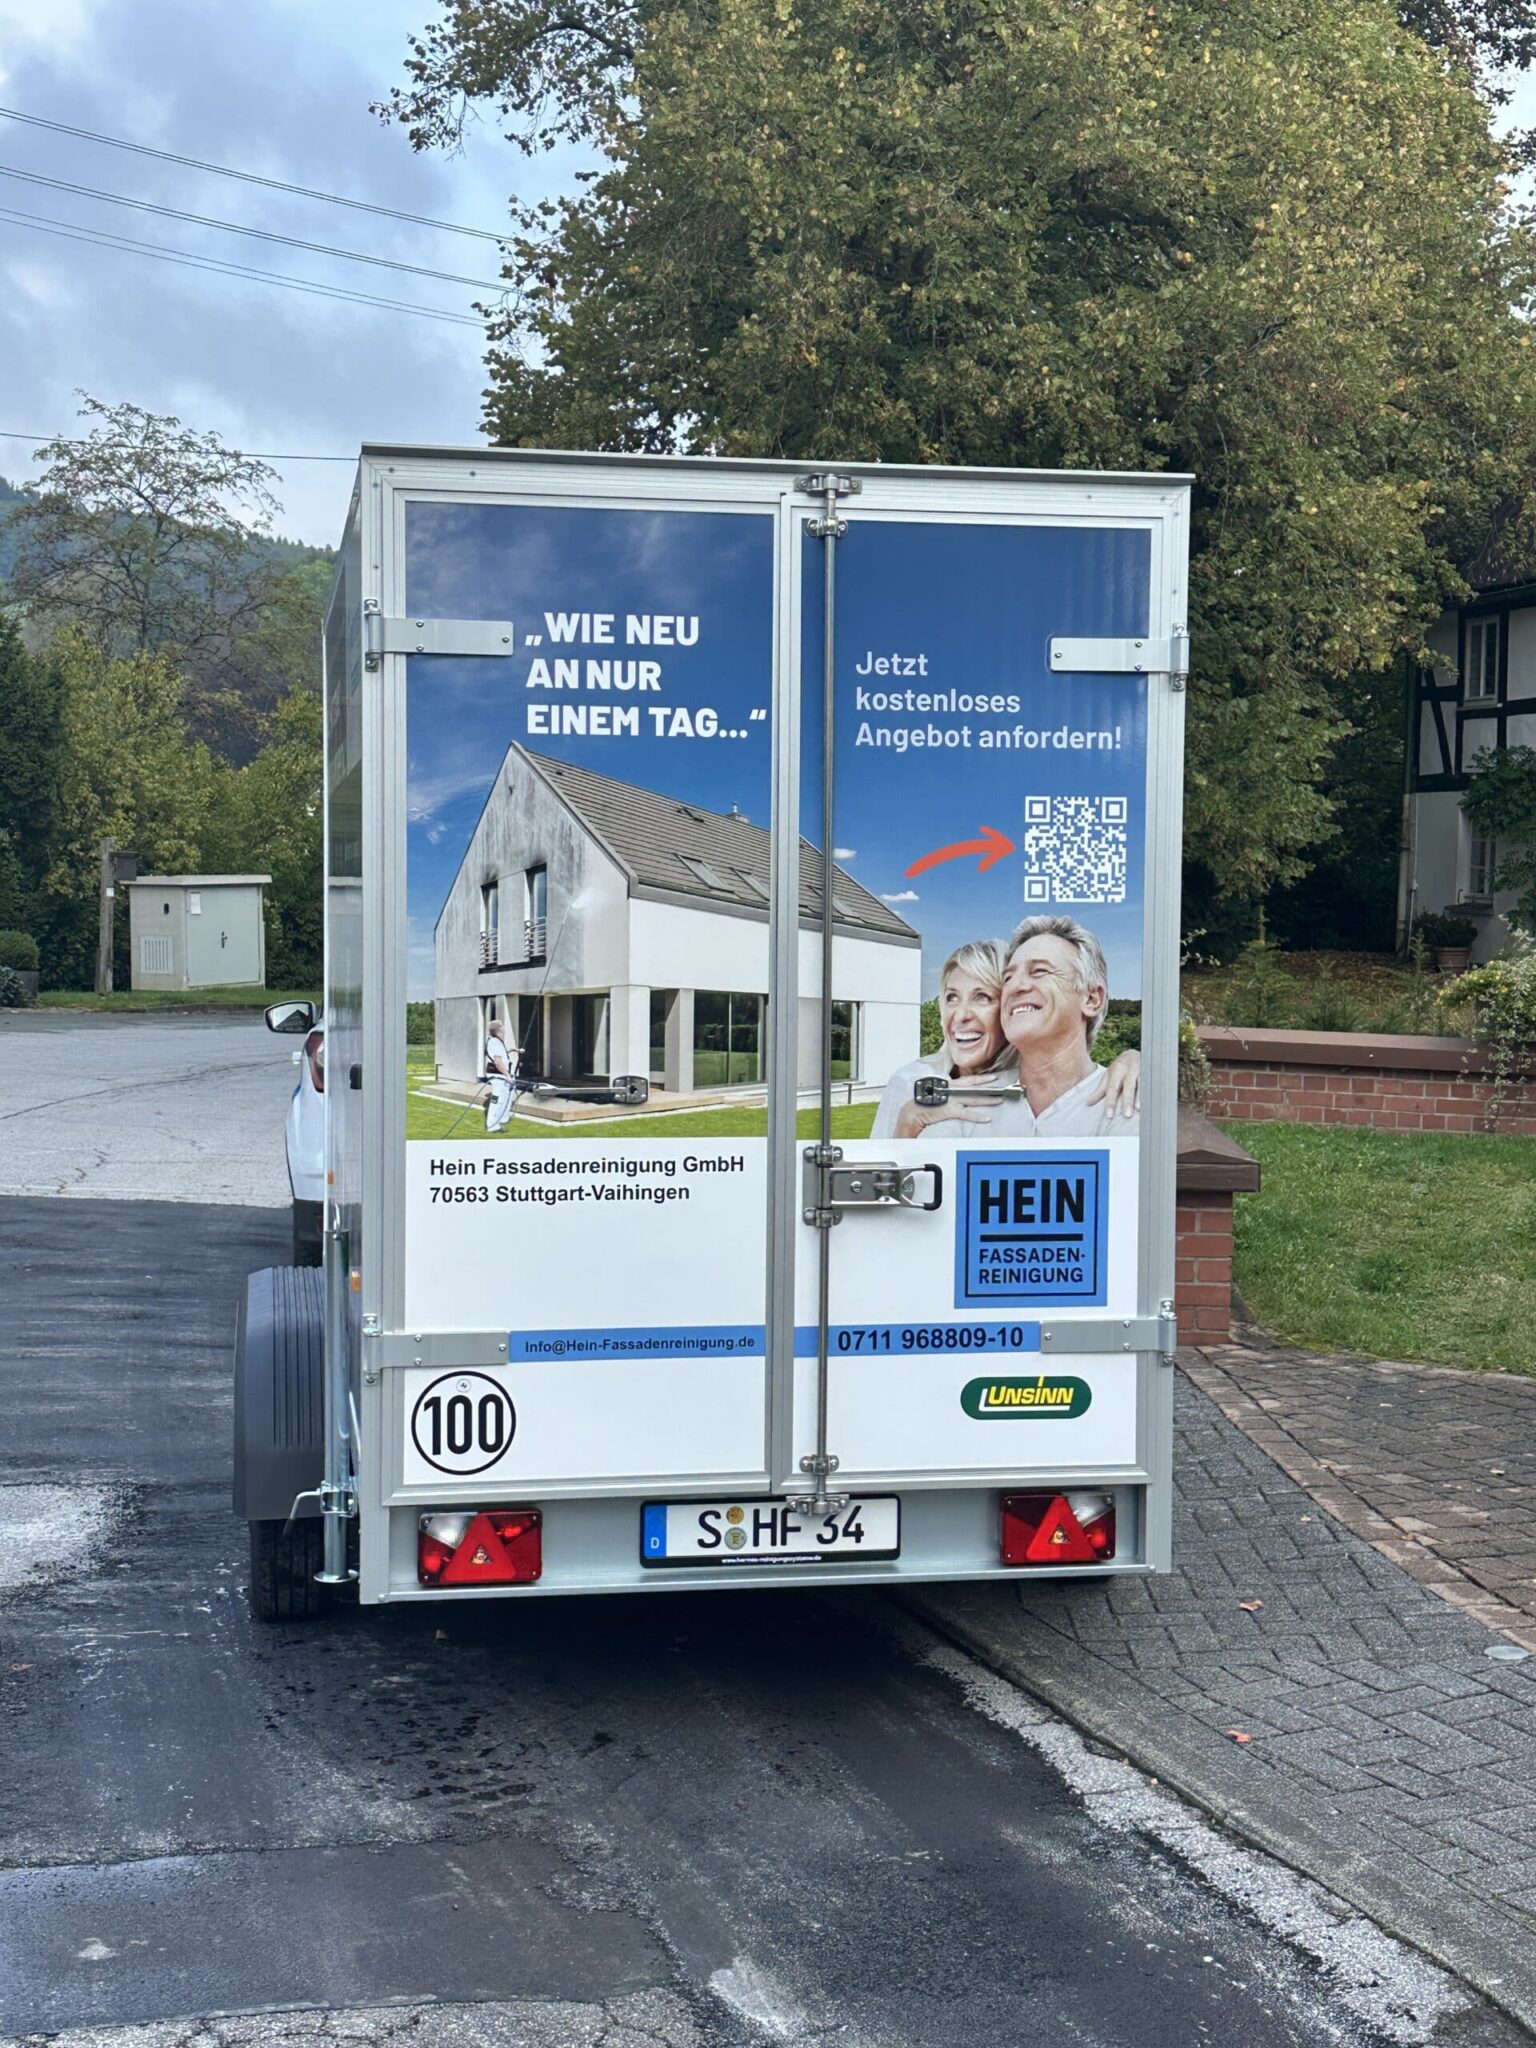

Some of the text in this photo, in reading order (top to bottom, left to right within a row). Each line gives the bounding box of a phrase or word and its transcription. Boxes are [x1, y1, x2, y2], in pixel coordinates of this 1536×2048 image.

[626, 614, 700, 646] NEU
[525, 658, 662, 691] AN NUR
[855, 651, 929, 676] Jetzt
[856, 686, 1022, 713] kostenloses
[527, 704, 640, 736] EINEM
[855, 722, 1122, 753] Angebot anfordern!
[430, 1156, 745, 1177] Hein Fassadenreinigung GmbH
[430, 1184, 690, 1206] 70563 Stuttgart-Vaihingen
[979, 1179, 1086, 1224] HEIN
[979, 1248, 1086, 1264] FASSADEN-
[978, 1268, 1084, 1285] REINIGUNG
[838, 1327, 1024, 1351] 0711 968809-10
[423, 1393, 505, 1456] 100
[697, 1505, 865, 1549] S HF 34
[650, 1537, 660, 1550] D
